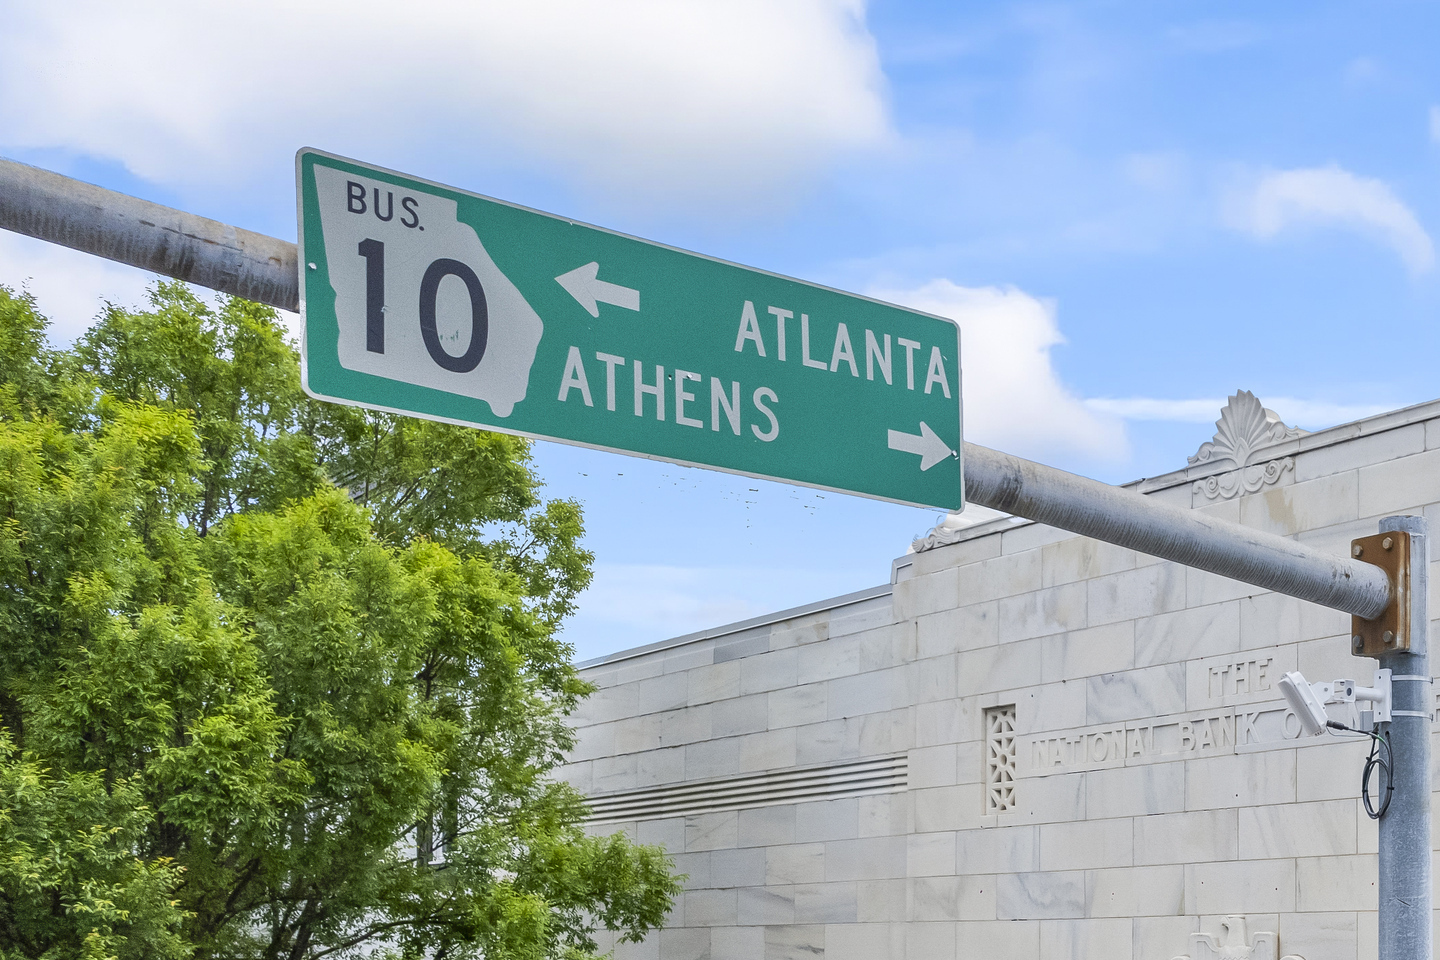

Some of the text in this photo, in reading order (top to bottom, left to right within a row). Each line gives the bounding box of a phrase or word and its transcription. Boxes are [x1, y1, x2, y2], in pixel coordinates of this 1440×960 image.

[346, 180, 425, 232] BUS.
[357, 237, 490, 373] 10
[735, 300, 951, 399] ATLANTA
[557, 345, 780, 442] ATHENS
[1209, 658, 1273, 698] THE
[1032, 725, 1162, 769] NATIONAL
[1177, 711, 1260, 752] BANK
